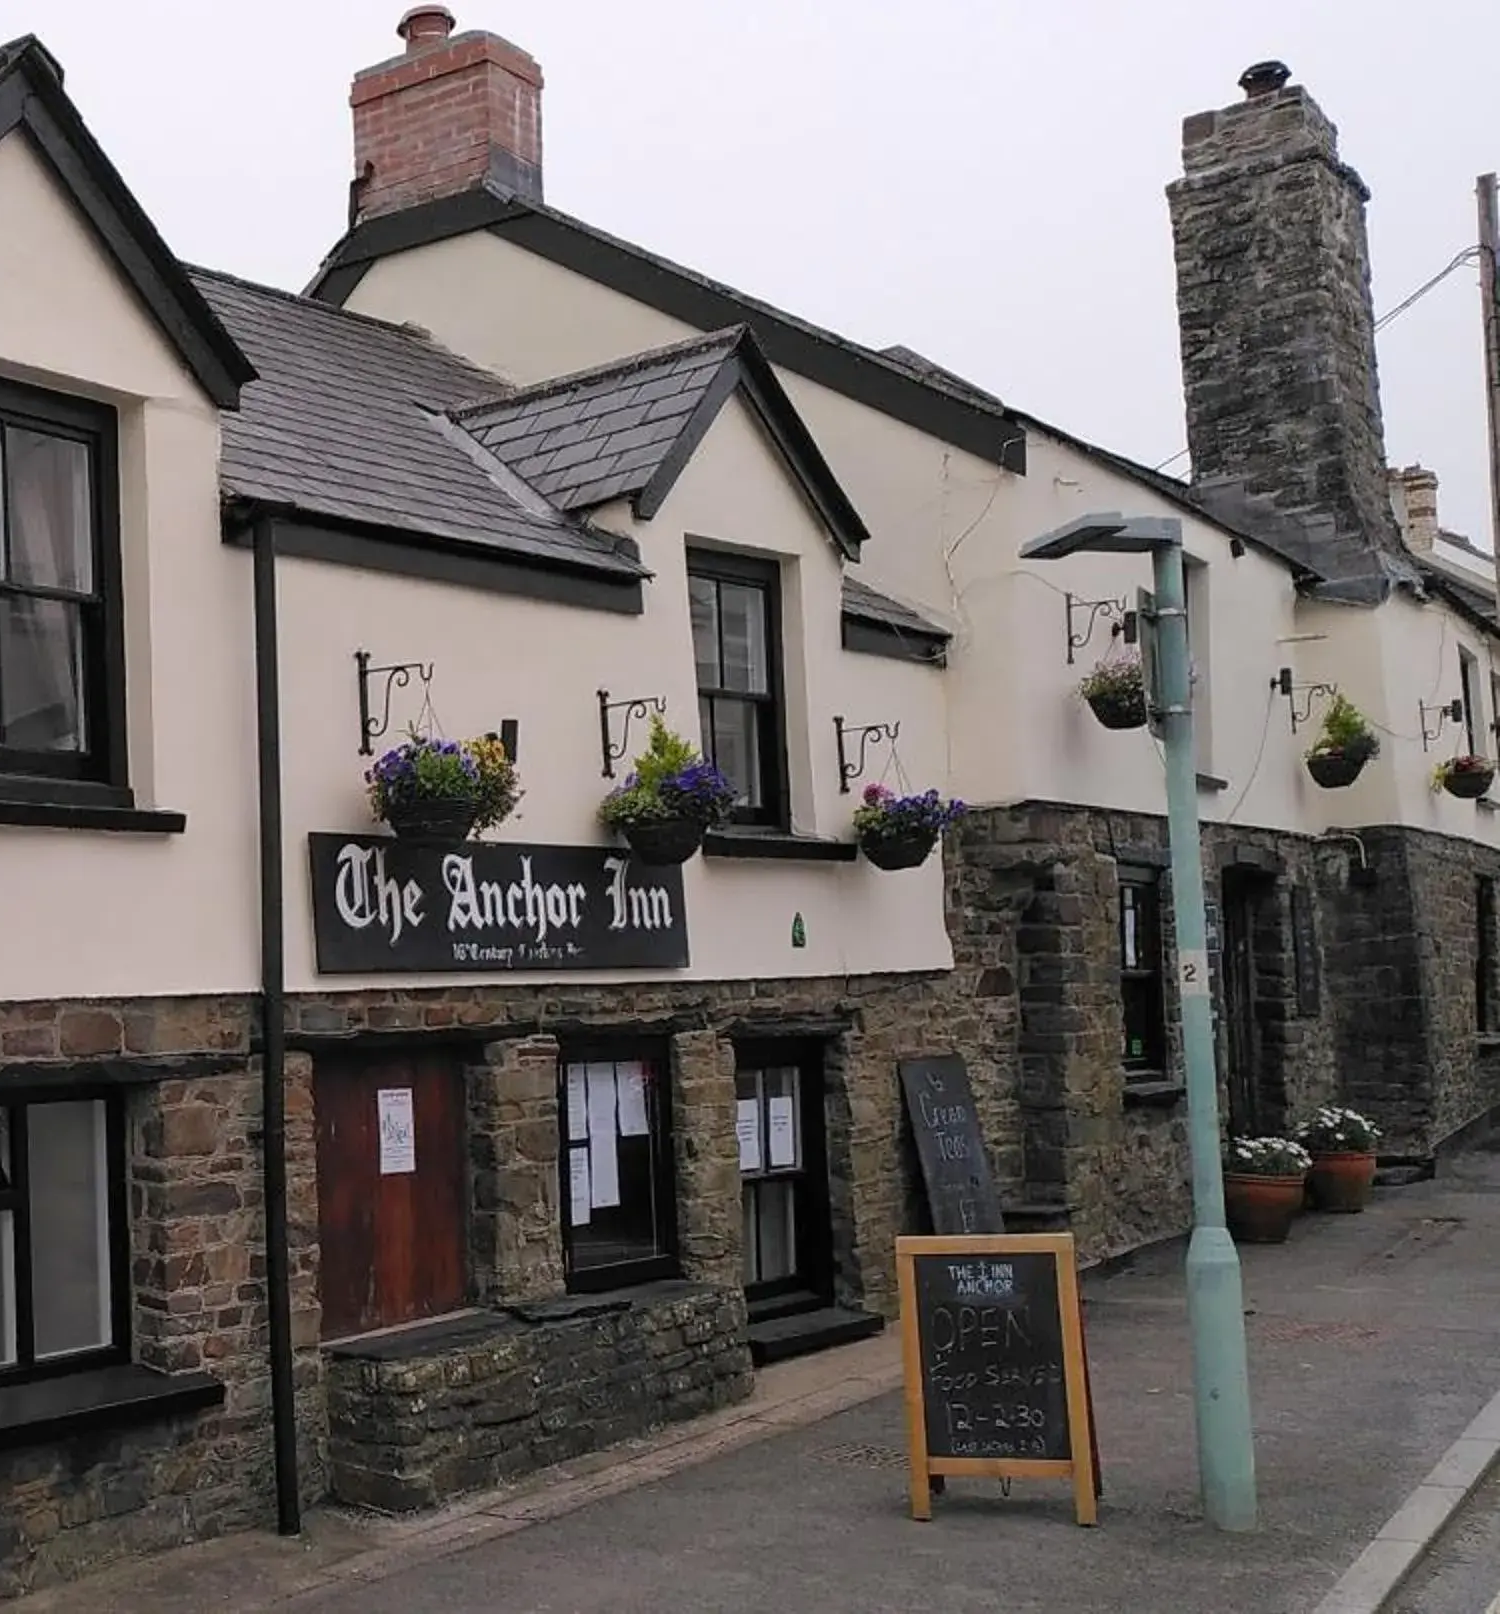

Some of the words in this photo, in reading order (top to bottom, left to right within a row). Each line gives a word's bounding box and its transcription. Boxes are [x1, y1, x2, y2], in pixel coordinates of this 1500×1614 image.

[335, 843, 425, 947] The
[441, 853, 587, 943] Anchor
[604, 856, 673, 930] Inn
[1183, 963, 1196, 983] 2
[948, 1264, 975, 1280] THE
[991, 1263, 1013, 1279] INN
[956, 1279, 1013, 1296] ANCHOR
[931, 1304, 1032, 1352] OPEN
